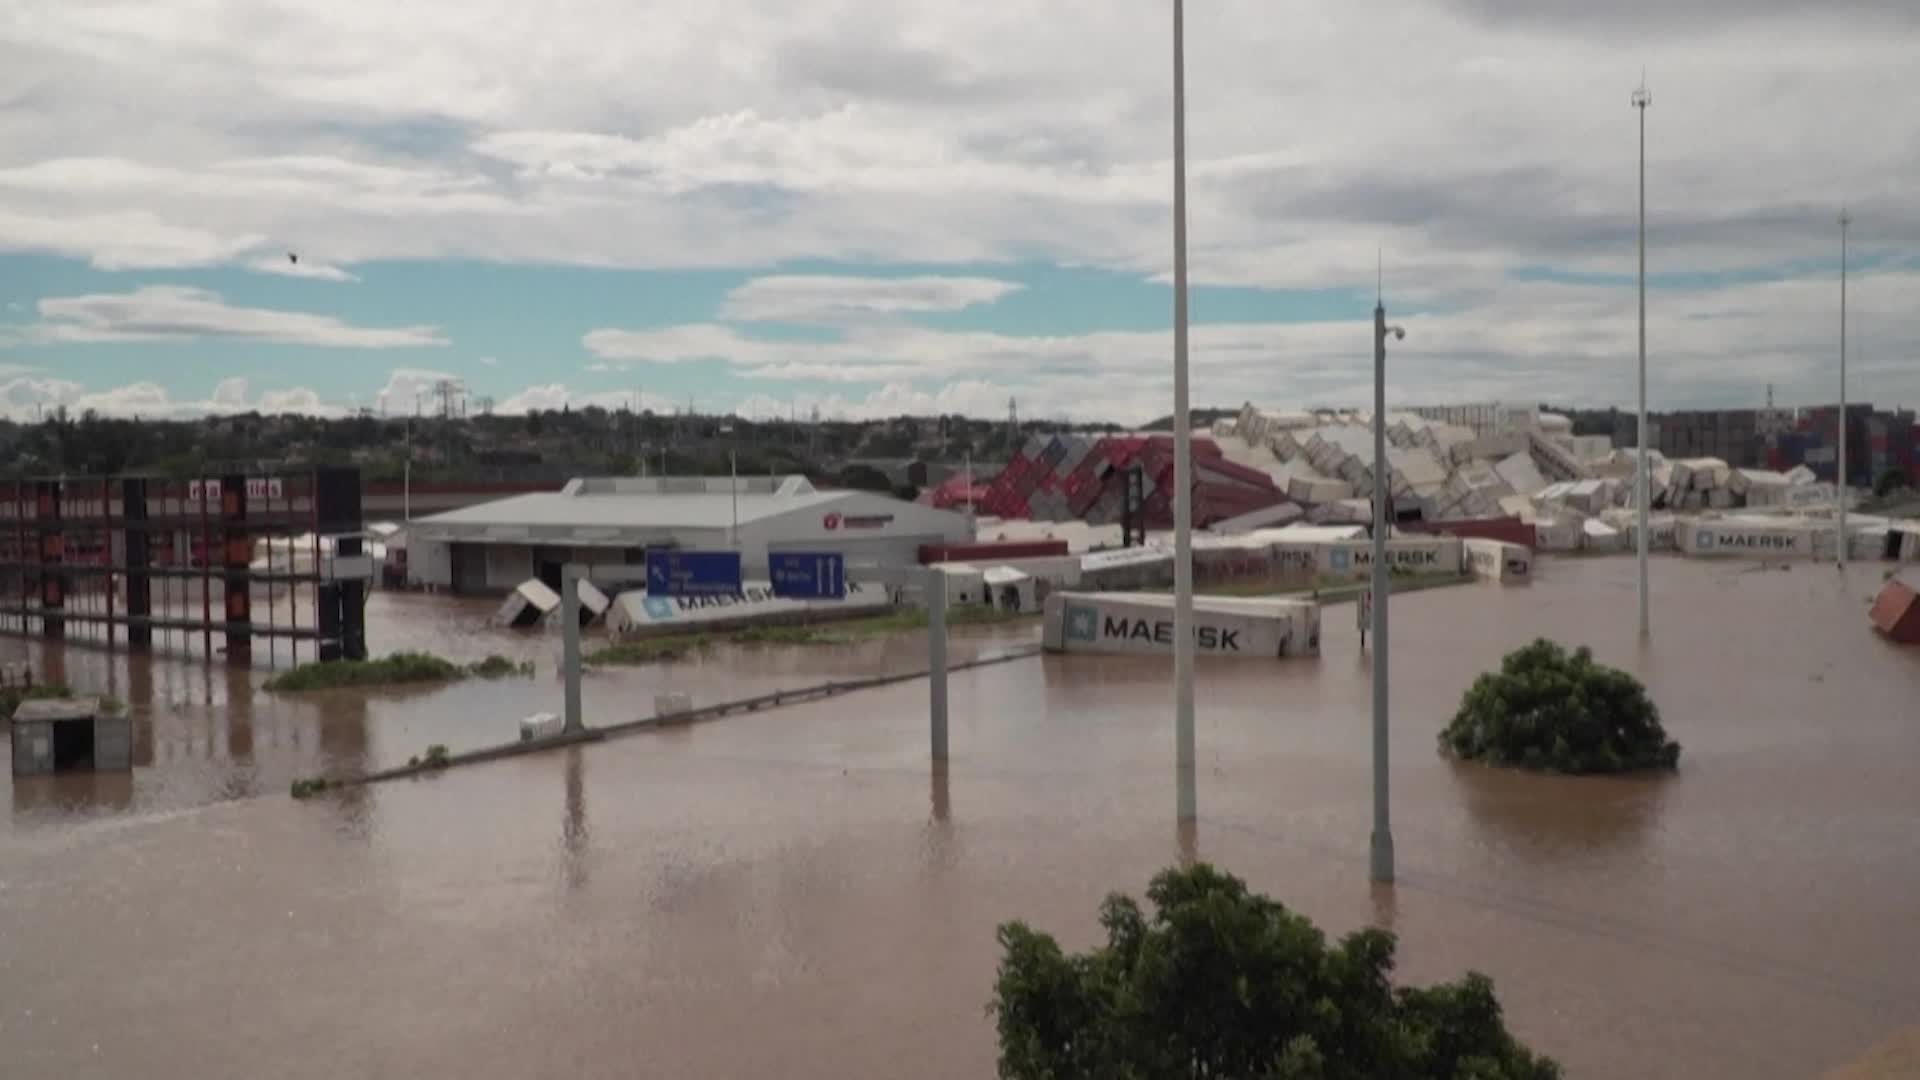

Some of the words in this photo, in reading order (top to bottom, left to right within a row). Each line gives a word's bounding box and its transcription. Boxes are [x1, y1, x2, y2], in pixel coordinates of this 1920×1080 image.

[1719, 533, 1797, 549] MAERSK
[1273, 549, 1313, 562] ERSK
[1103, 615, 1241, 652] MAESK
